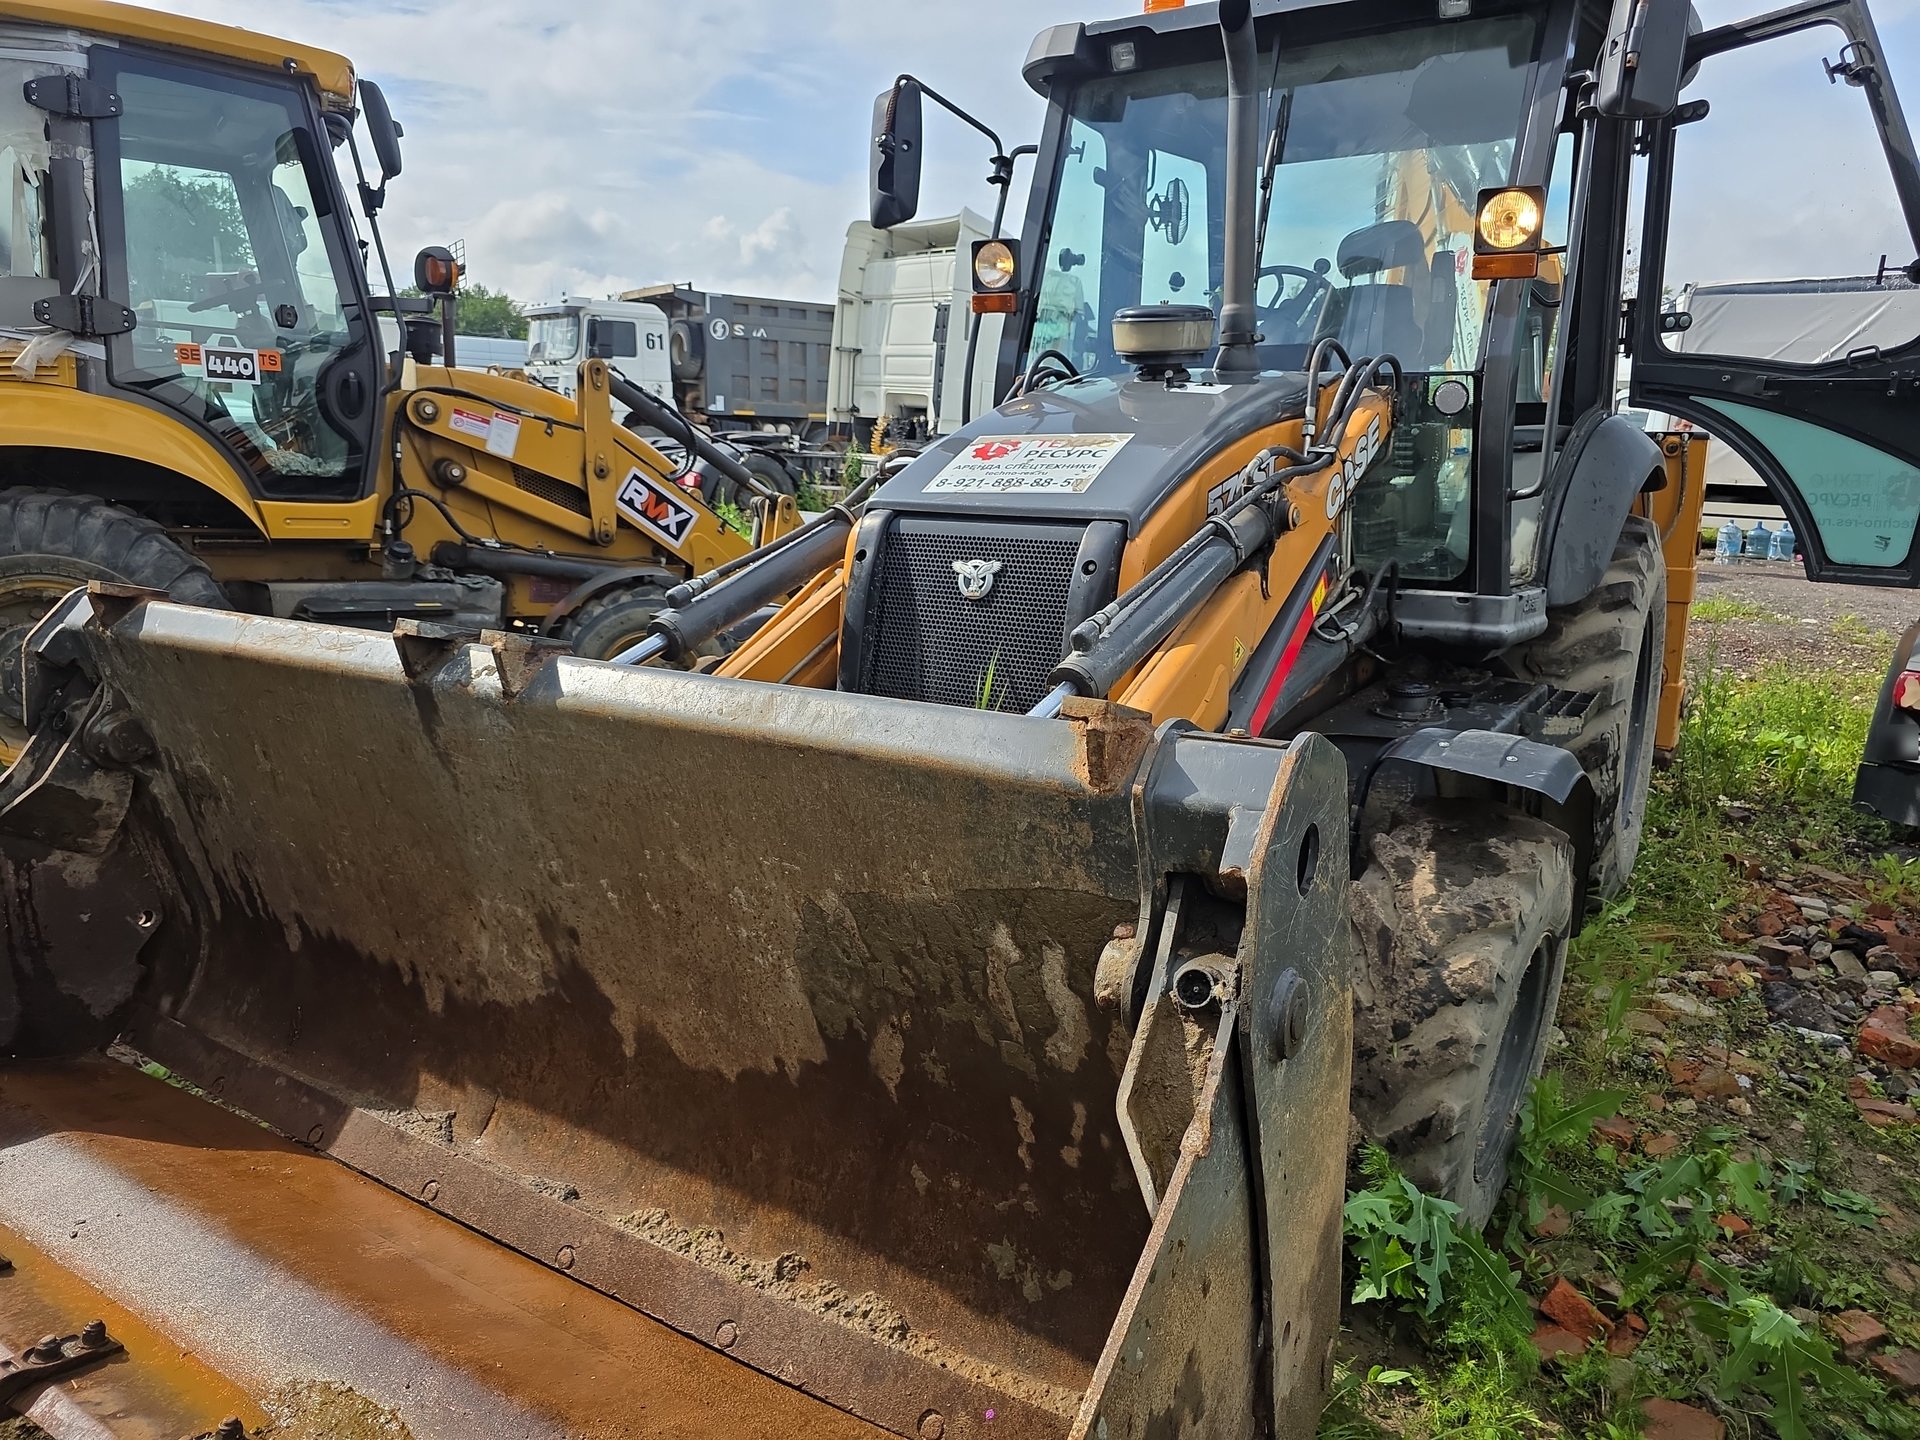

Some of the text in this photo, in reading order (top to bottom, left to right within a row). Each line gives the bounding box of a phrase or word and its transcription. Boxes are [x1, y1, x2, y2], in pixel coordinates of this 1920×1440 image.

[646, 332, 665, 351] 61
[207, 355, 254, 376] 440
[564, 387, 577, 400] 6
[1024, 449, 1108, 458] РЕСУРС
[1004, 463, 1097, 471] СПЕЦТЕХНИКИ
[1326, 412, 1381, 521] CASE
[936, 478, 1083, 489] 8-921-888-88-5
[622, 479, 691, 536] RMX
